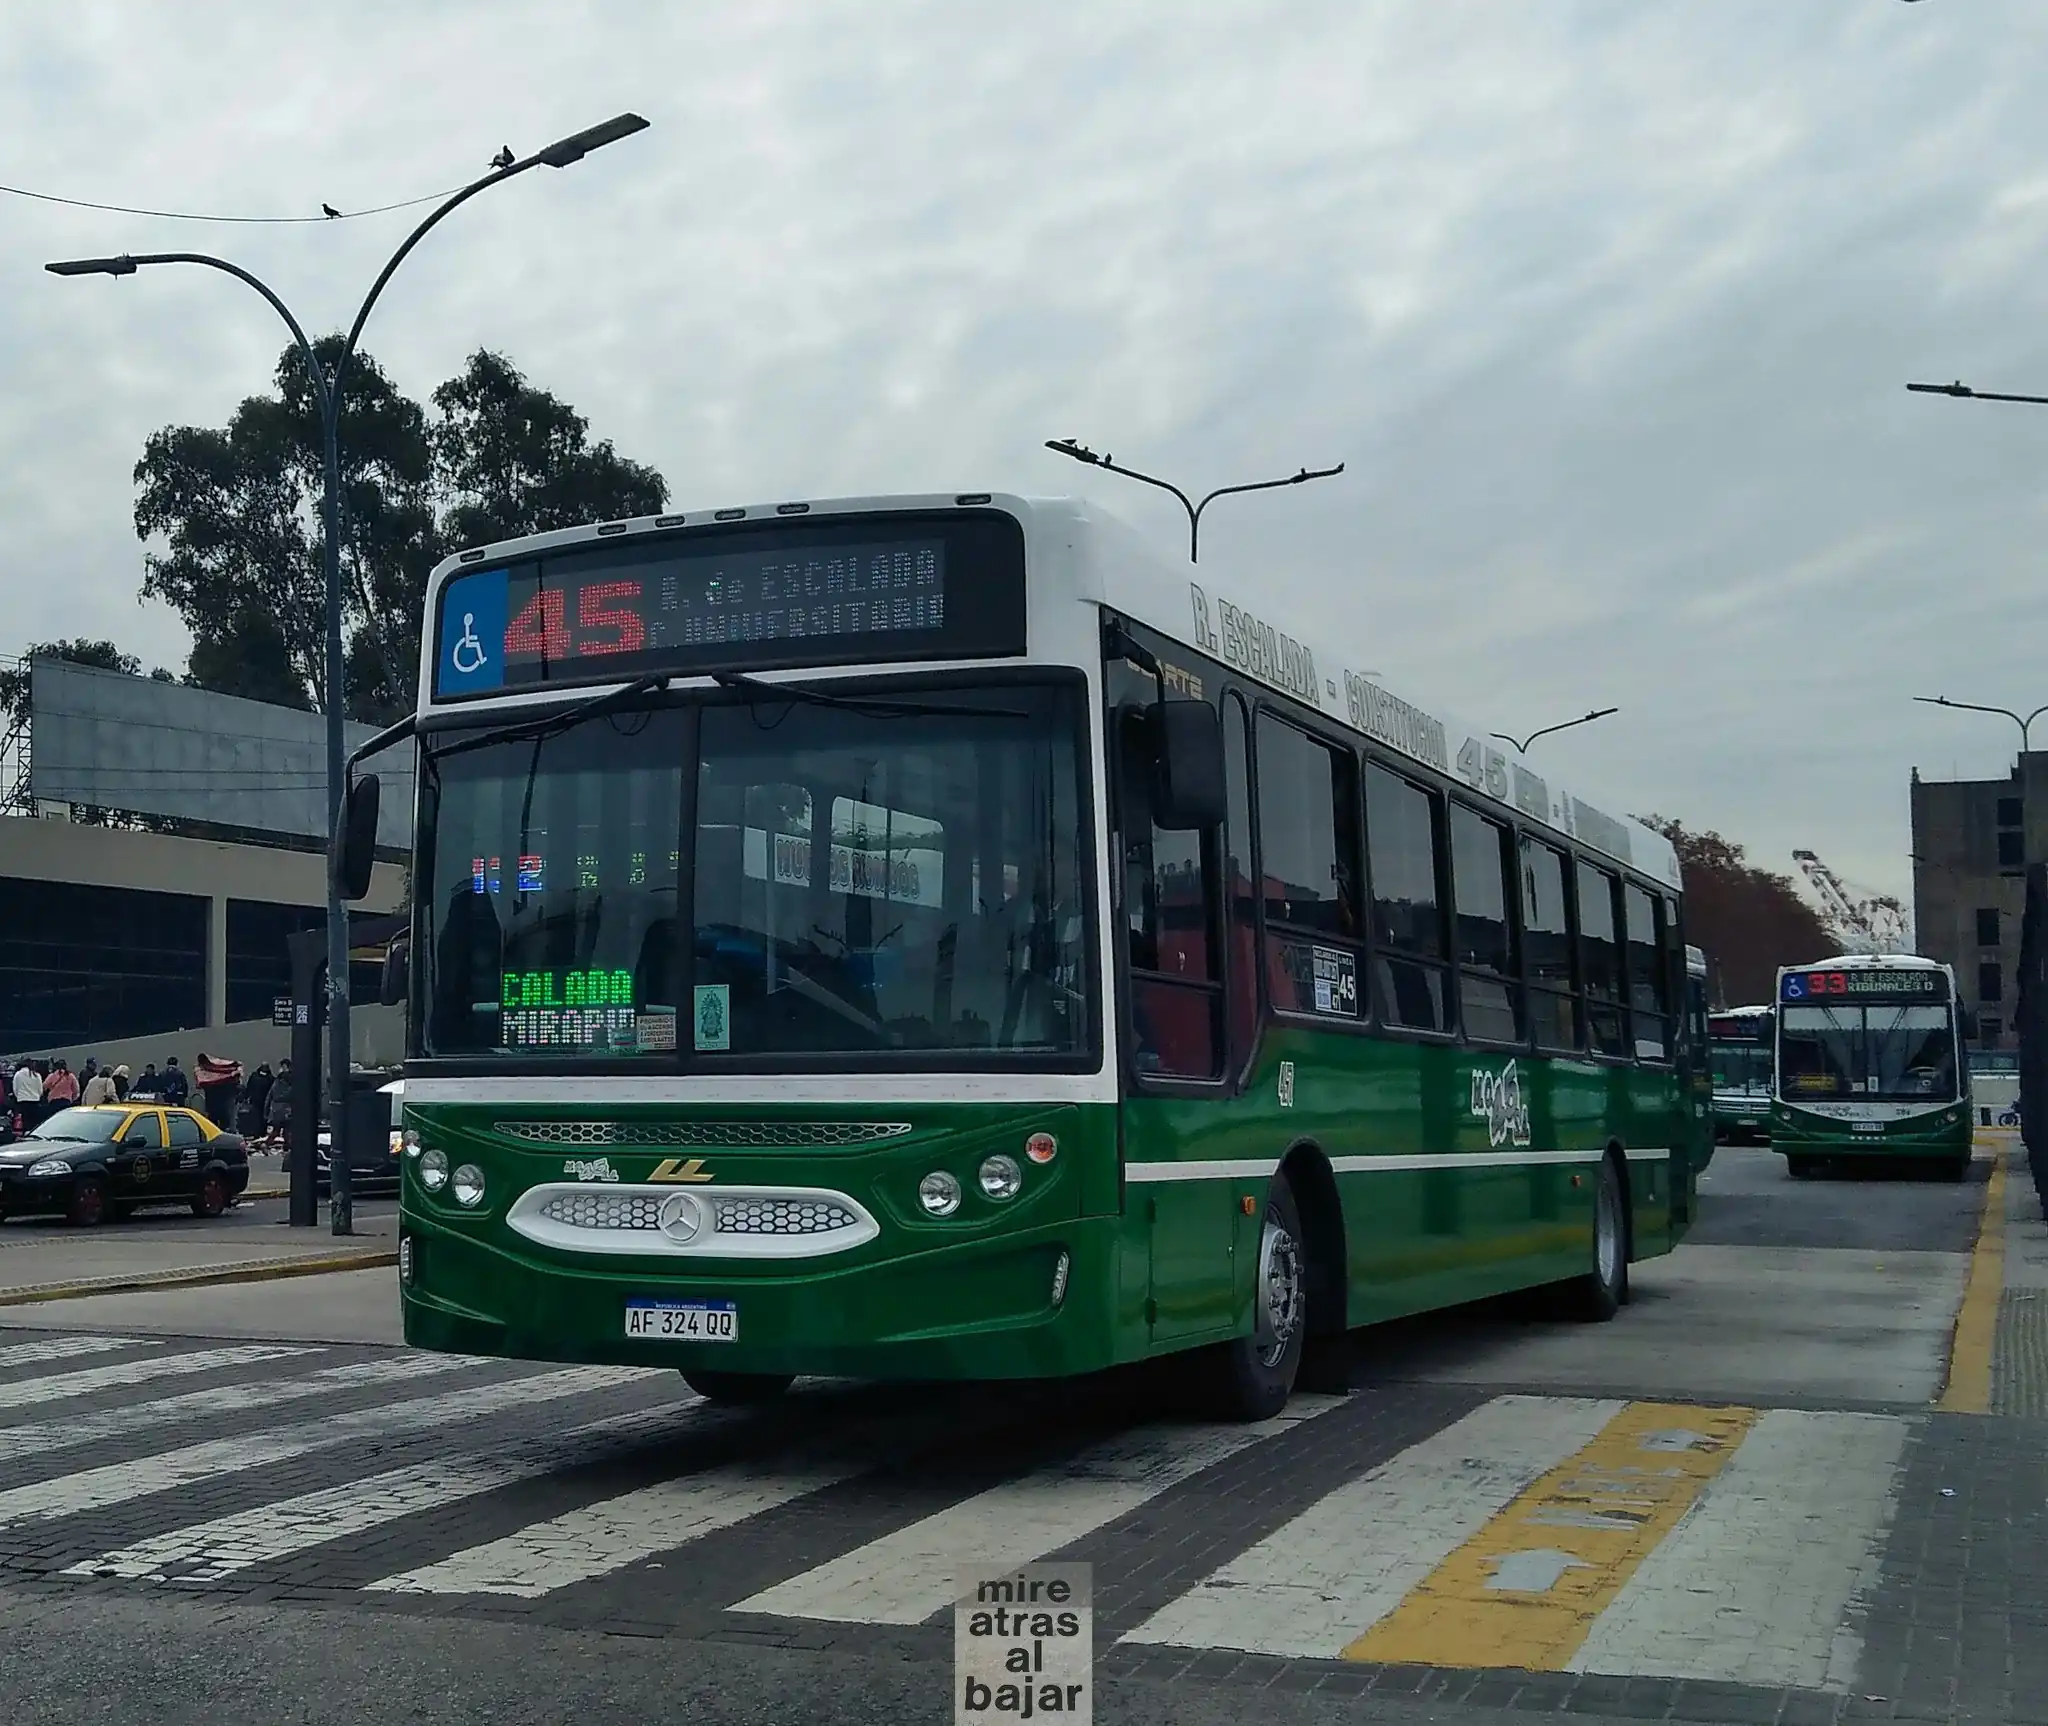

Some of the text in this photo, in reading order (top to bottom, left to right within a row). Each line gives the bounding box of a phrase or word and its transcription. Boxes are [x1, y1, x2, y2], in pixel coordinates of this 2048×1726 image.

[760, 549, 936, 600] ESCALADA
[503, 579, 645, 660] 45
[1190, 582, 1217, 653] R.
[1218, 598, 1321, 708] ESCALADA
[1456, 737, 1508, 799] 45
[1340, 973, 1356, 1001] 45
[1808, 973, 1848, 993] 33
[630, 1310, 732, 1336] AF 324 QQ
